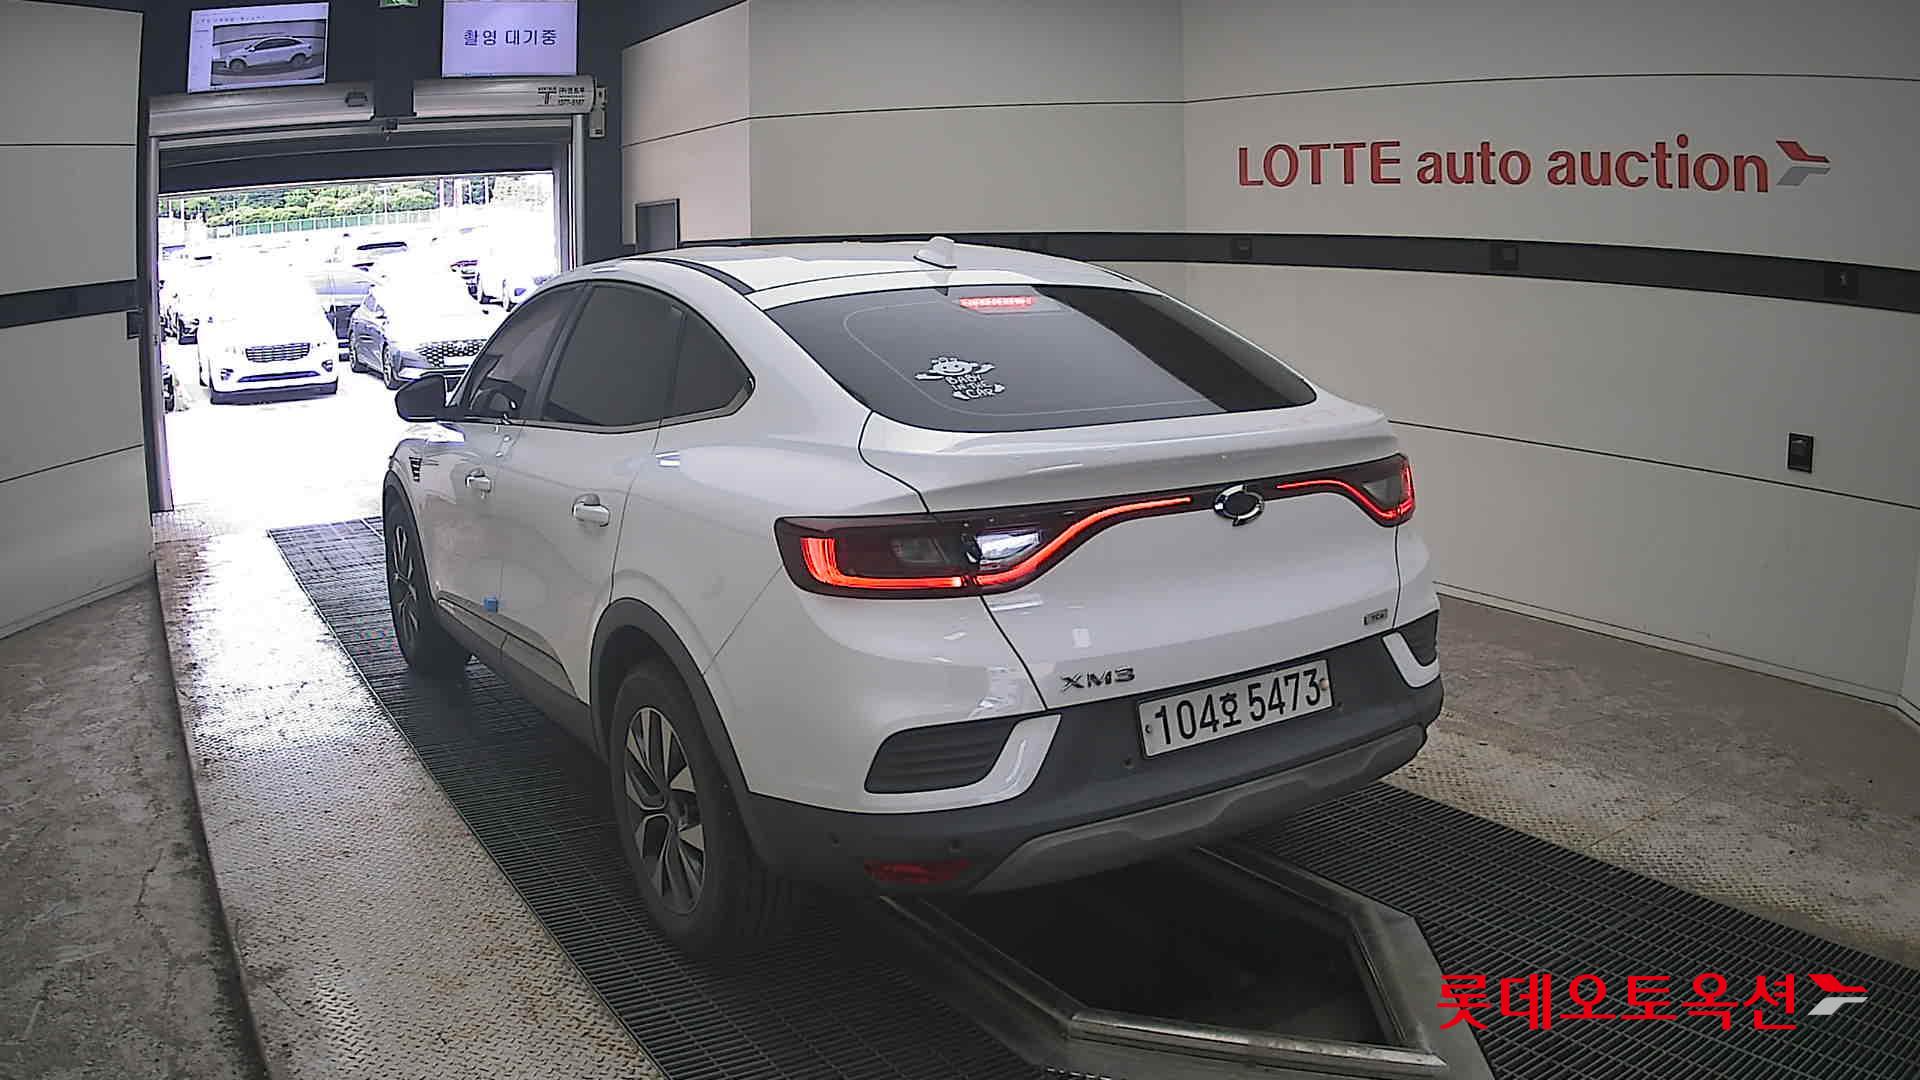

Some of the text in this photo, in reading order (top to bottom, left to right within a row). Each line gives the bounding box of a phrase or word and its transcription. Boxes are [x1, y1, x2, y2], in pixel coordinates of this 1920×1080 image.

[505, 29, 558, 46] 대기중
[1238, 134, 1768, 193] LOTTE auto auction
[944, 374, 983, 385] BABY
[966, 387, 996, 399] CAR
[1060, 666, 1136, 692] XM3
[1154, 667, 1321, 745] 104호 5473
